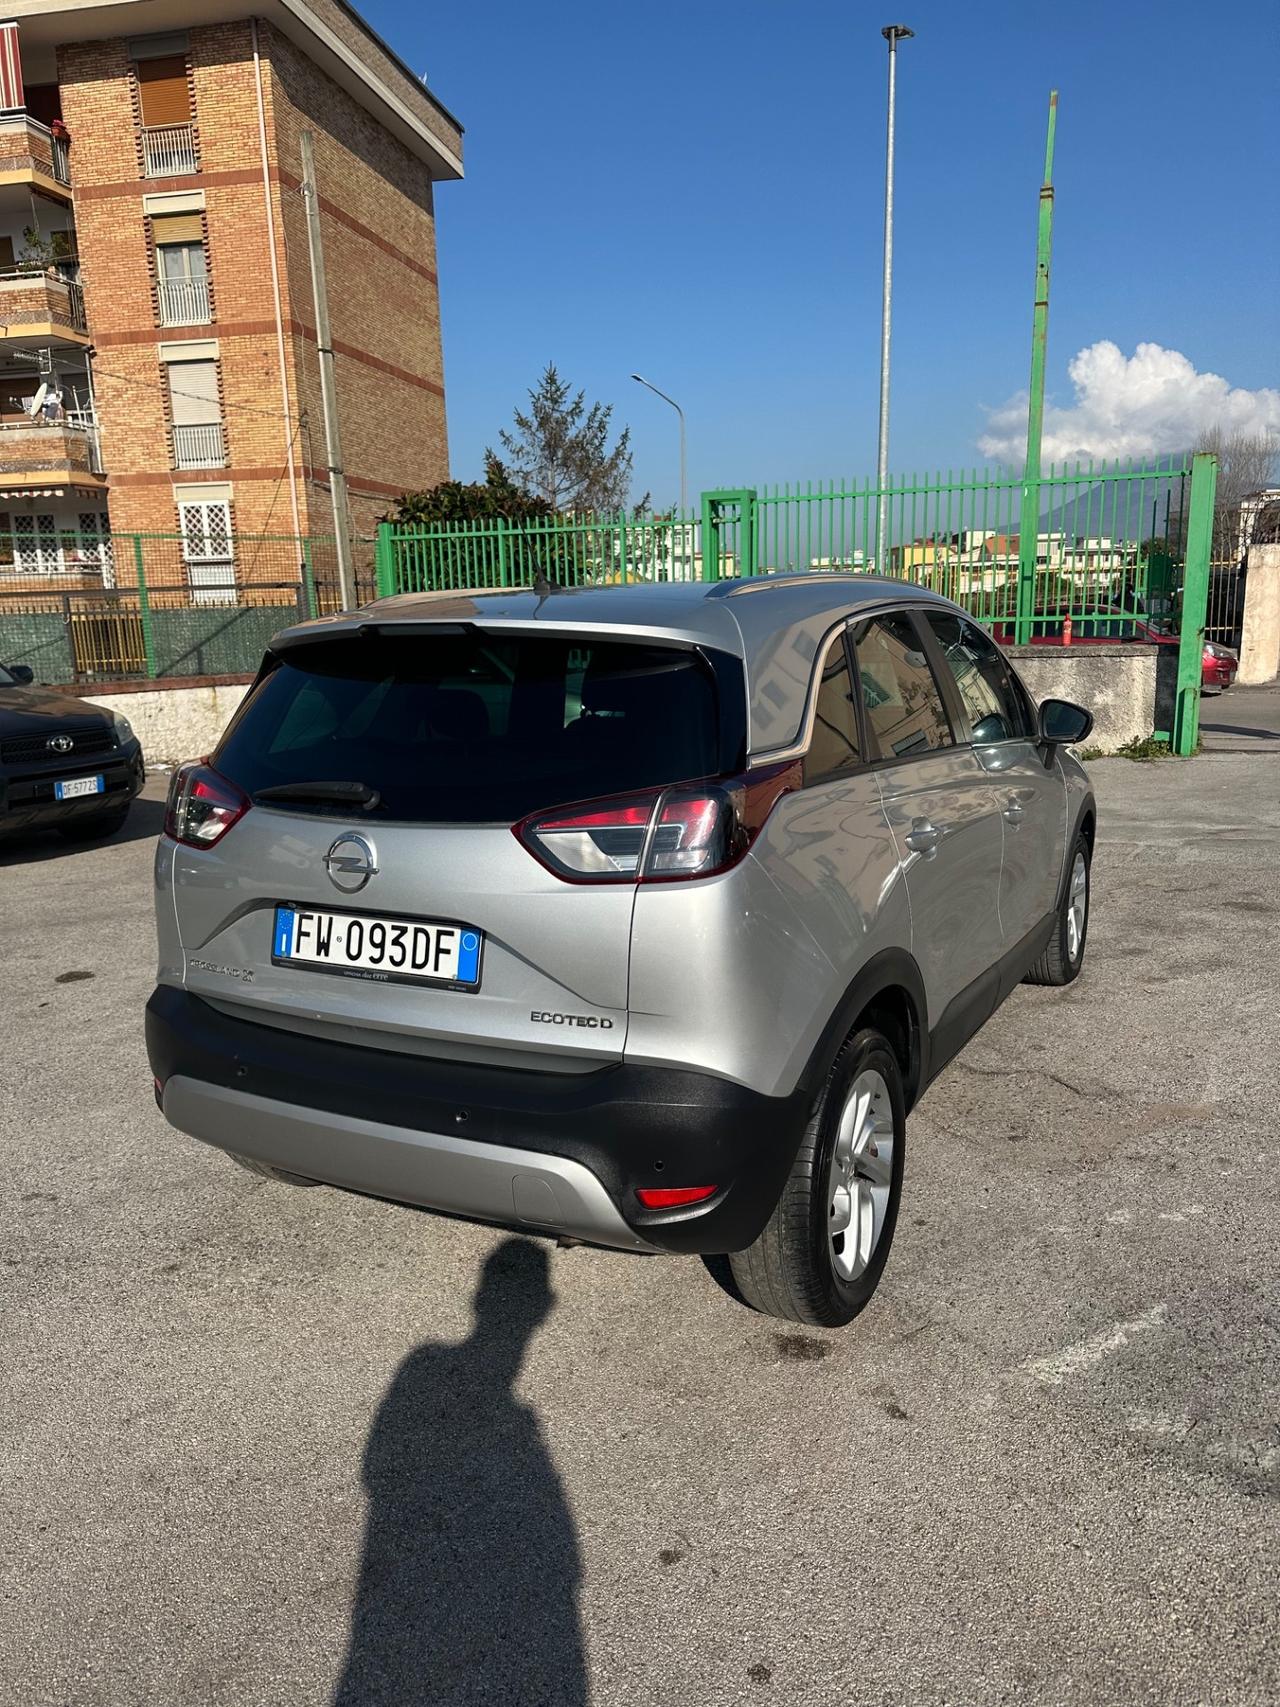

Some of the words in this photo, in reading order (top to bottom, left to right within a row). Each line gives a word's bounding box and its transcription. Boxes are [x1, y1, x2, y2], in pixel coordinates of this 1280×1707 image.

[295, 913, 333, 957] FW
[345, 919, 455, 972] 093DF
[530, 1010, 598, 1029] ECOTEC
[600, 1018, 613, 1029] D
